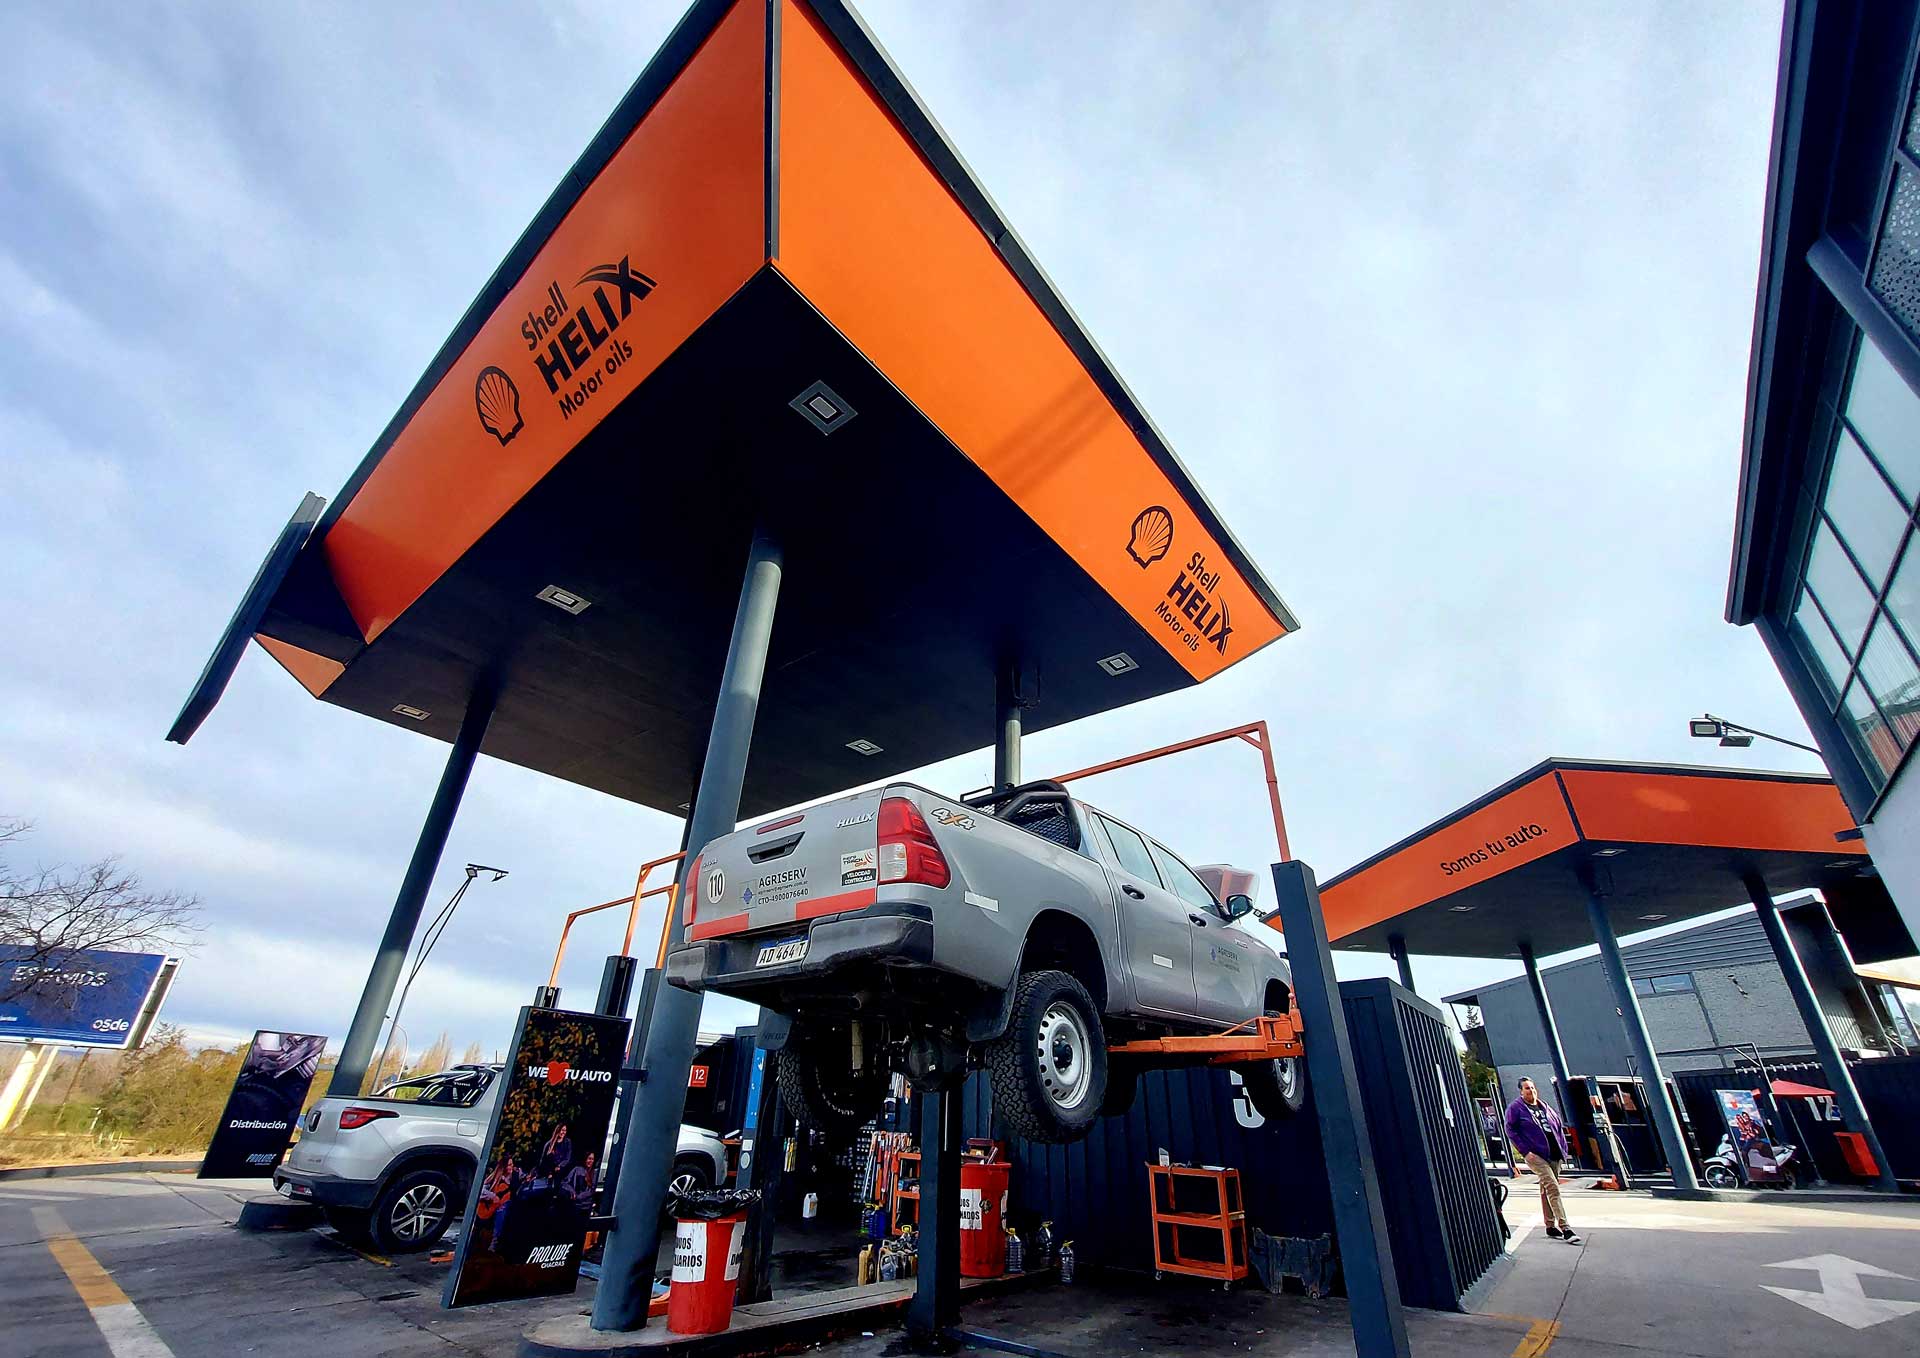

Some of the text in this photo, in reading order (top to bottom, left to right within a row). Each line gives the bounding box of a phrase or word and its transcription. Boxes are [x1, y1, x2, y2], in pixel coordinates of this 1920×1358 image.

[521, 280, 568, 351] Shell
[534, 254, 658, 395] HELIX
[558, 339, 632, 420] Motor oils
[1186, 552, 1220, 593] Shell
[1166, 570, 1233, 656] HELIX
[1154, 600, 1200, 652] Motor oils
[837, 811, 875, 828] HILUX
[1440, 823, 1548, 876] Somos tu auto.
[709, 872, 724, 898] 110
[758, 867, 807, 888] AGRISERV
[758, 949, 774, 964] AD
[776, 944, 796, 960] 464
[92, 1018, 129, 1032] osde
[528, 1066, 612, 1082] WE TU AUTO
[695, 1069, 705, 1080] 12
[229, 1120, 287, 1130] Distribución
[526, 1243, 574, 1265] PROLUBE
